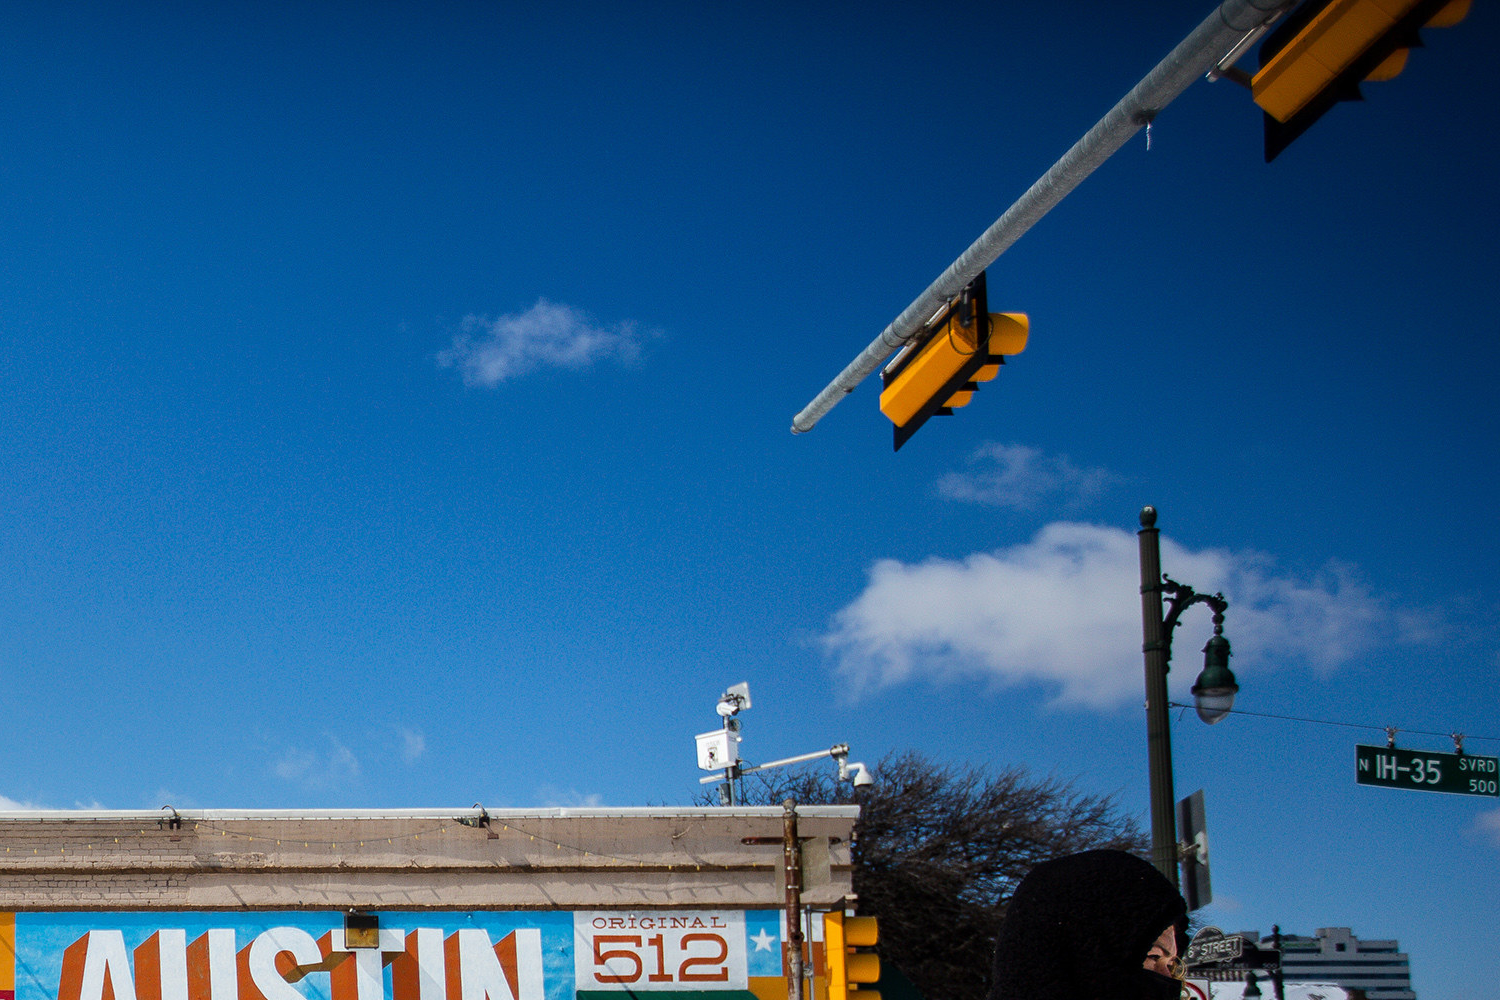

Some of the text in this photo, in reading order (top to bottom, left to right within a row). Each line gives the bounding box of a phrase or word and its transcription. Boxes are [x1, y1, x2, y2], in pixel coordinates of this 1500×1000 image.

[1359, 754, 1496, 784] N IH-35 SVRD
[1469, 779, 1497, 793] 500
[592, 917, 727, 930] ORIGINAL
[1201, 938, 1239, 956] STREET
[593, 933, 729, 982] 512
